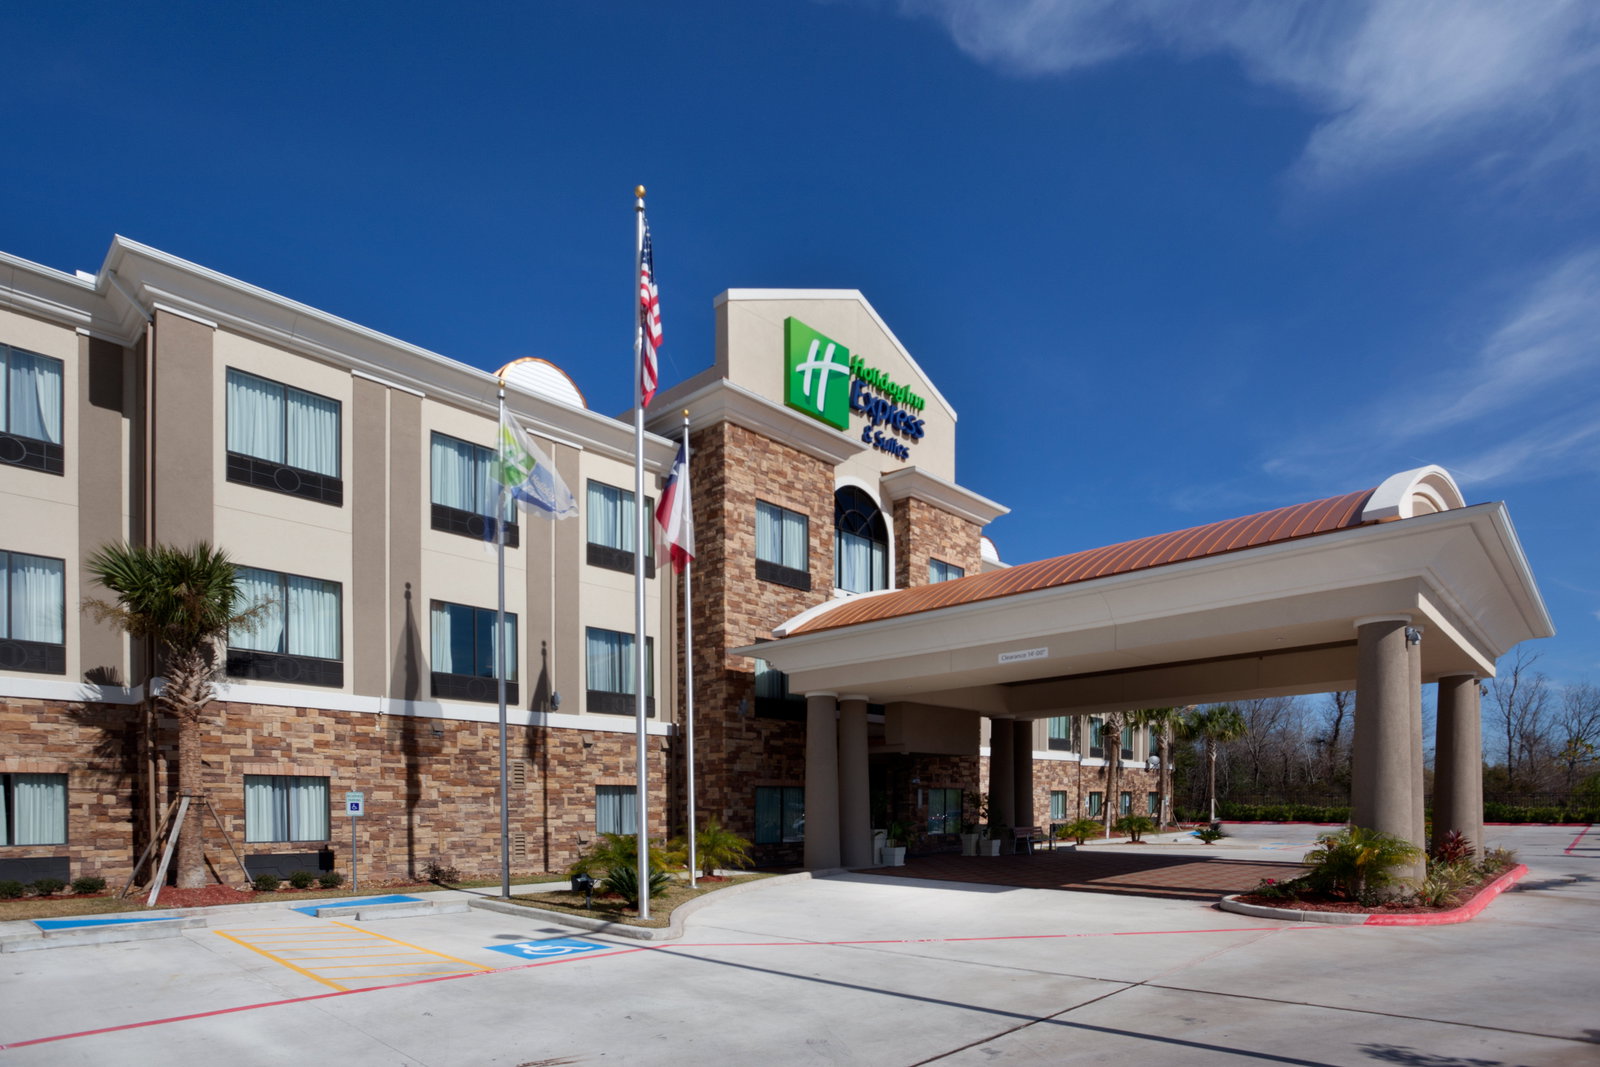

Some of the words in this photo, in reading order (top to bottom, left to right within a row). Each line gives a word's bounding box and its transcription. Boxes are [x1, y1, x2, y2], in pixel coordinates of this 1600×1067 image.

[850, 354, 906, 402] Holiday
[905, 384, 926, 411] Inn
[850, 379, 925, 439] Express
[862, 425, 873, 444] &
[873, 430, 910, 460] Suites
[1001, 653, 1027, 662] Clearance
